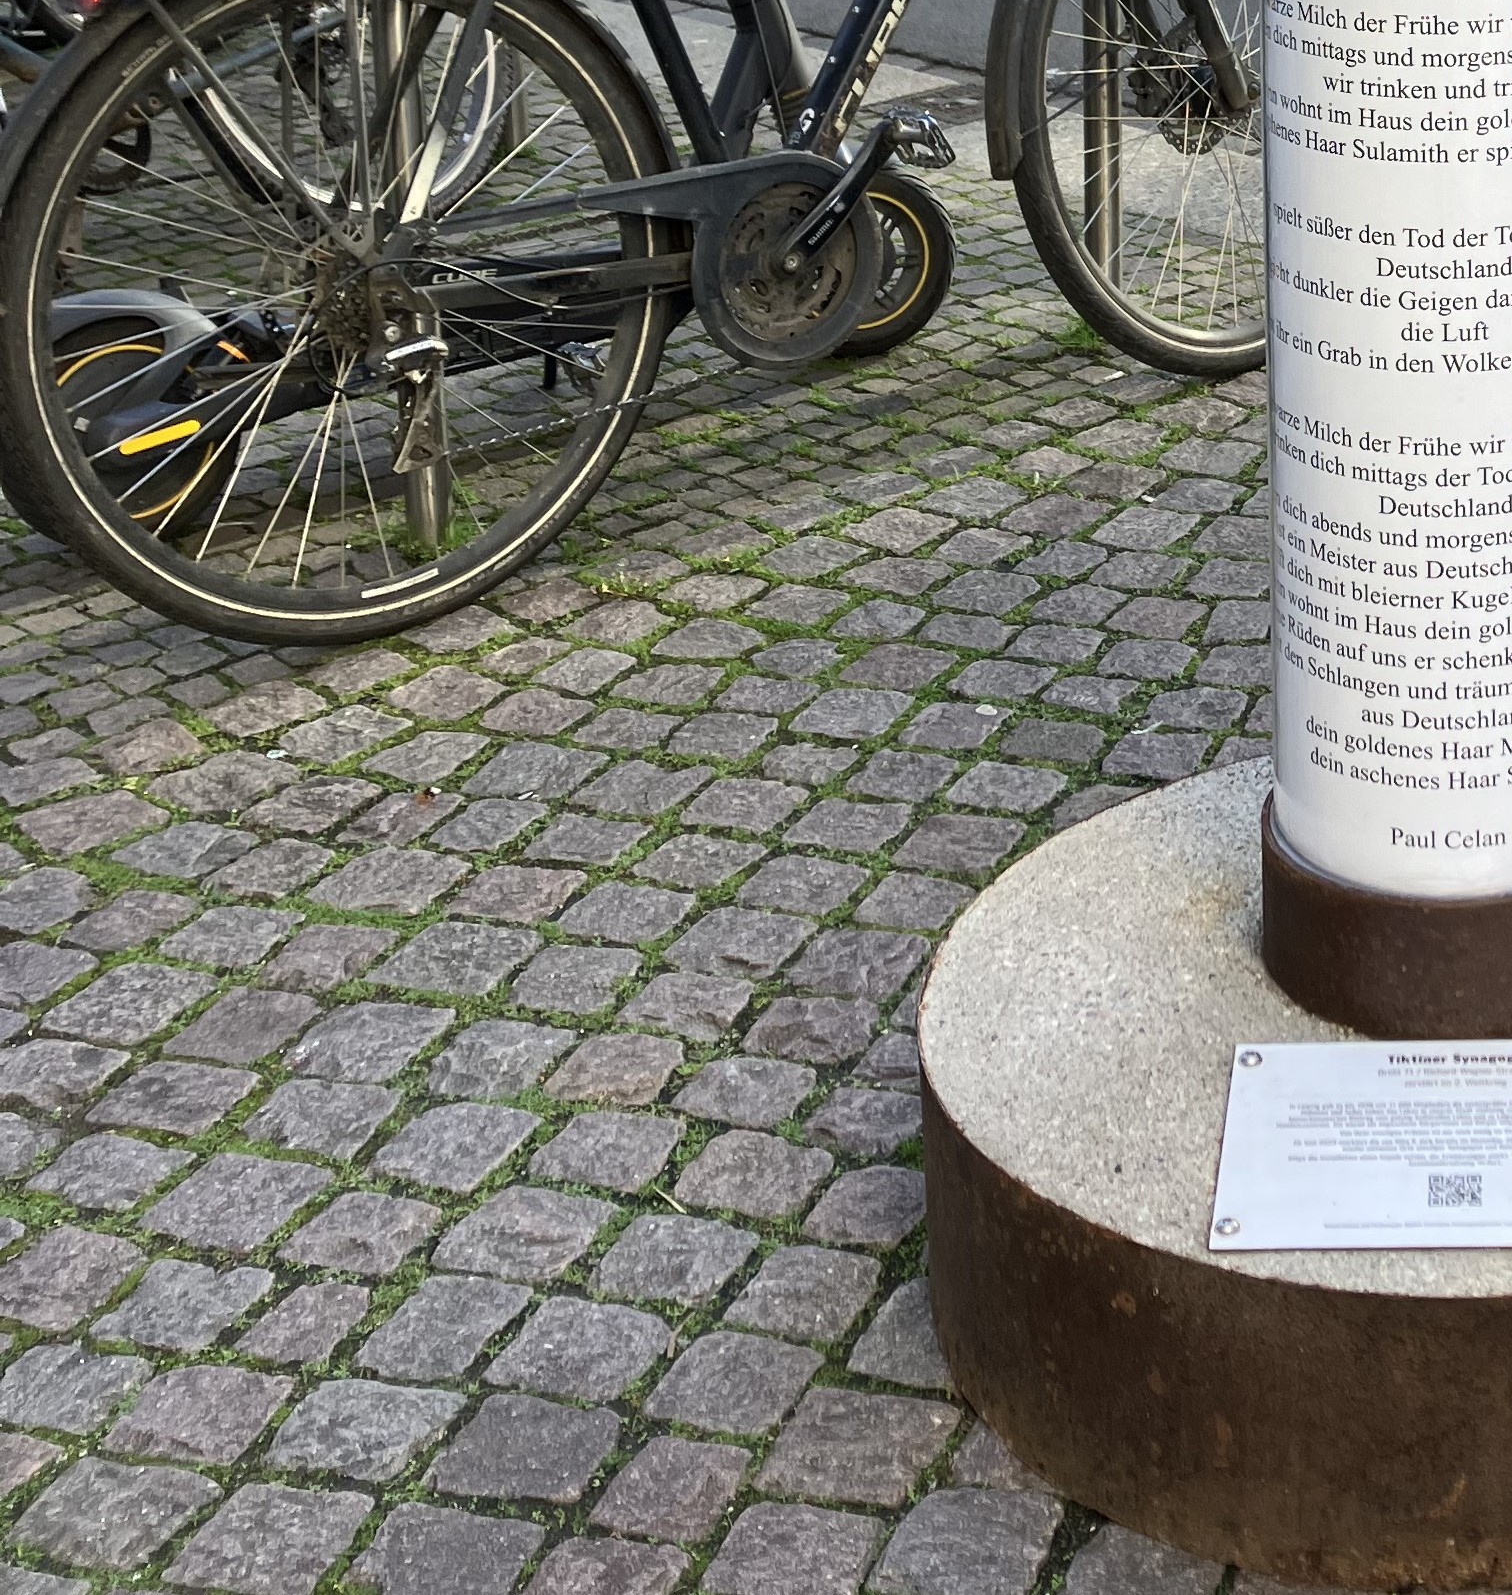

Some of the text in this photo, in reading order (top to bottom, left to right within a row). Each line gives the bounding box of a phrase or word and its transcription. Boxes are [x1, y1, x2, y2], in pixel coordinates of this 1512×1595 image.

[1322, 69, 1354, 101] wir
[1359, 77, 1438, 102] trinken
[1443, 78, 1487, 99] und
[1305, 216, 1353, 241] süßer
[1359, 224, 1396, 246] den
[1402, 228, 1446, 249] Tod
[1453, 228, 1488, 248] der
[1376, 256, 1512, 280] Deutschland
[1401, 320, 1490, 344] die Luft
[1309, 447, 1346, 477] dich
[1351, 458, 1428, 493] mittags
[1435, 468, 1471, 487] der
[1287, 525, 1306, 554] ein
[1308, 537, 1377, 574] Meister
[1383, 562, 1417, 581] aus
[1287, 613, 1331, 653] Rüden
[1336, 641, 1368, 663] auf
[1371, 646, 1406, 668] uns
[1414, 654, 1435, 676] er
[1361, 700, 1394, 727] aus
[1306, 715, 1339, 745] dein
[1344, 734, 1433, 762] goldenes
[1440, 741, 1494, 762] Haar
[1311, 743, 1344, 776] dein
[1350, 761, 1439, 790] aschenes
[1448, 770, 1500, 790] Haar
[1390, 827, 1506, 850] Paul Celan
